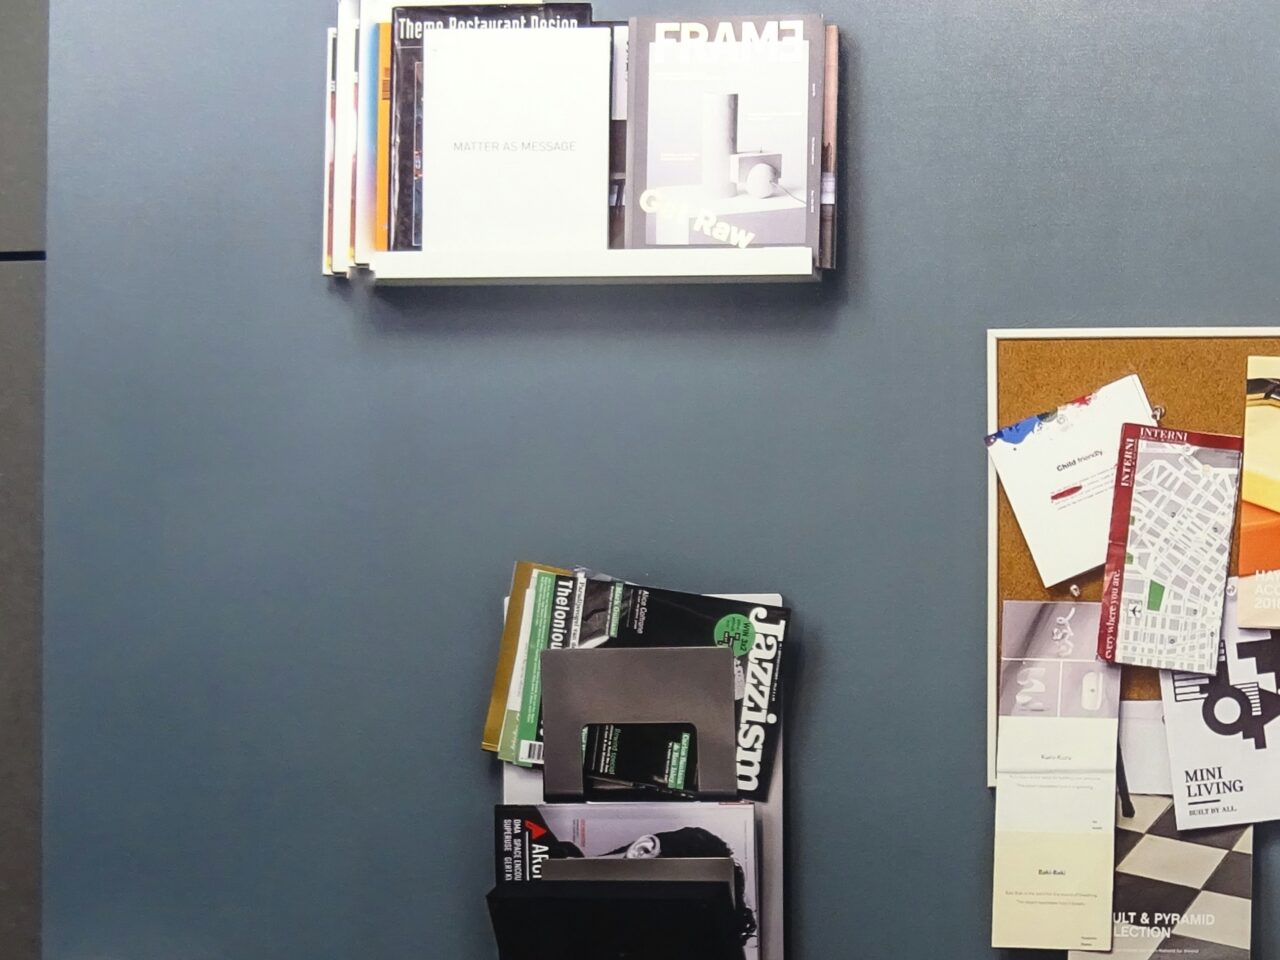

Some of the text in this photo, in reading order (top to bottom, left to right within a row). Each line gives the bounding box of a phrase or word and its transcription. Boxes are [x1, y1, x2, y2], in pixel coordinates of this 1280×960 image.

[453, 141, 577, 153] MATTER AS MESSAGE
[693, 208, 756, 249] Raw
[1140, 426, 1188, 442] INTERNI
[1056, 459, 1077, 472] Child
[1121, 438, 1135, 487] INTERNI
[1255, 569, 1280, 582] HAY
[550, 580, 574, 649] Theloniou
[742, 622, 751, 637] WIN
[735, 606, 786, 791] Jazzism
[1184, 766, 1223, 783] MINI
[1187, 779, 1244, 797] LIVING
[1189, 808, 1209, 816] BUILT
[1211, 807, 1220, 815] BY
[503, 819, 512, 852] SUPERUSE
[513, 838, 522, 858] SPACE
[513, 859, 522, 881] ENCOU
[1112, 911, 1216, 926] ULT & PYRAMID
[1113, 926, 1171, 939] LECTION
